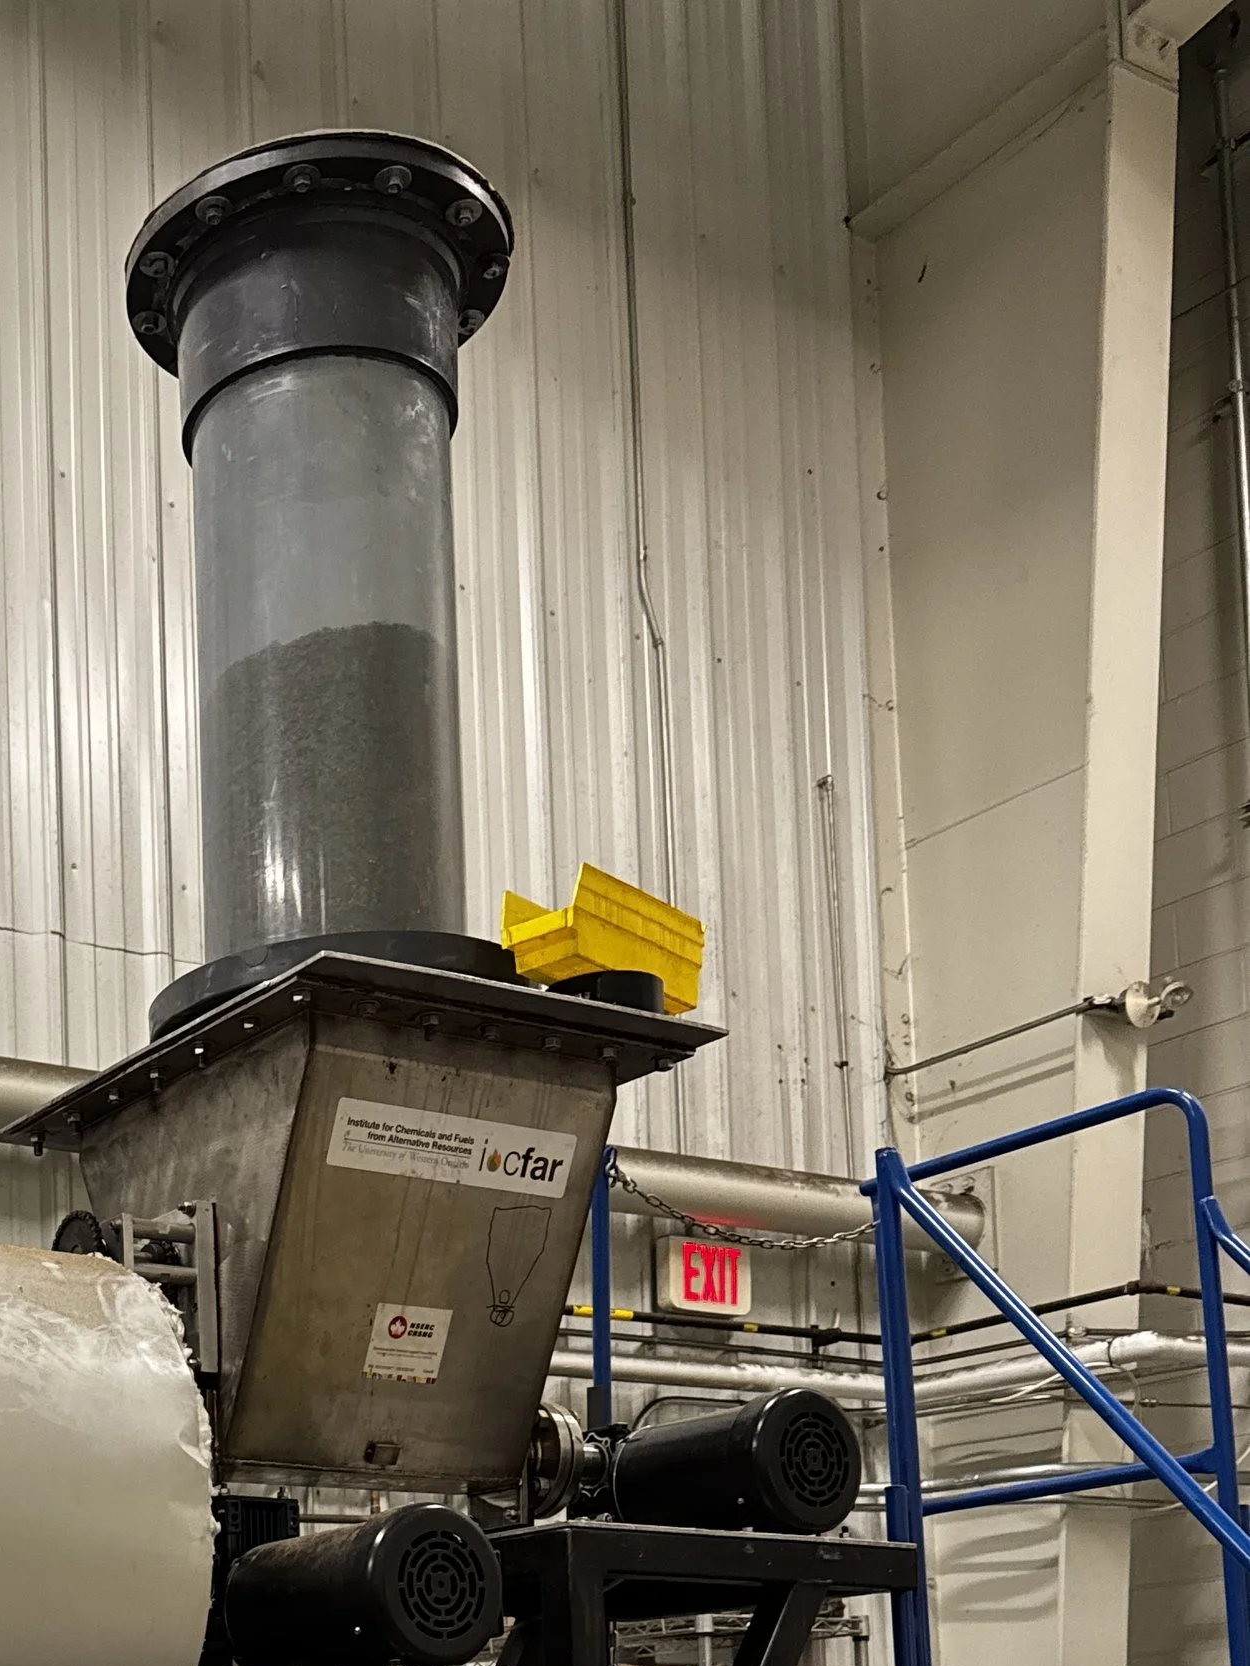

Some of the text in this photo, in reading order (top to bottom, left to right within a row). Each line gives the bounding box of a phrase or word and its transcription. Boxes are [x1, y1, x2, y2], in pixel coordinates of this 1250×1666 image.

[347, 1116, 475, 1145] Institute for Chemicals and Fuels
[367, 1131, 472, 1155] from Alternative Resources
[682, 1242, 741, 1306] EXIT
[410, 1322, 435, 1331] NSERC
